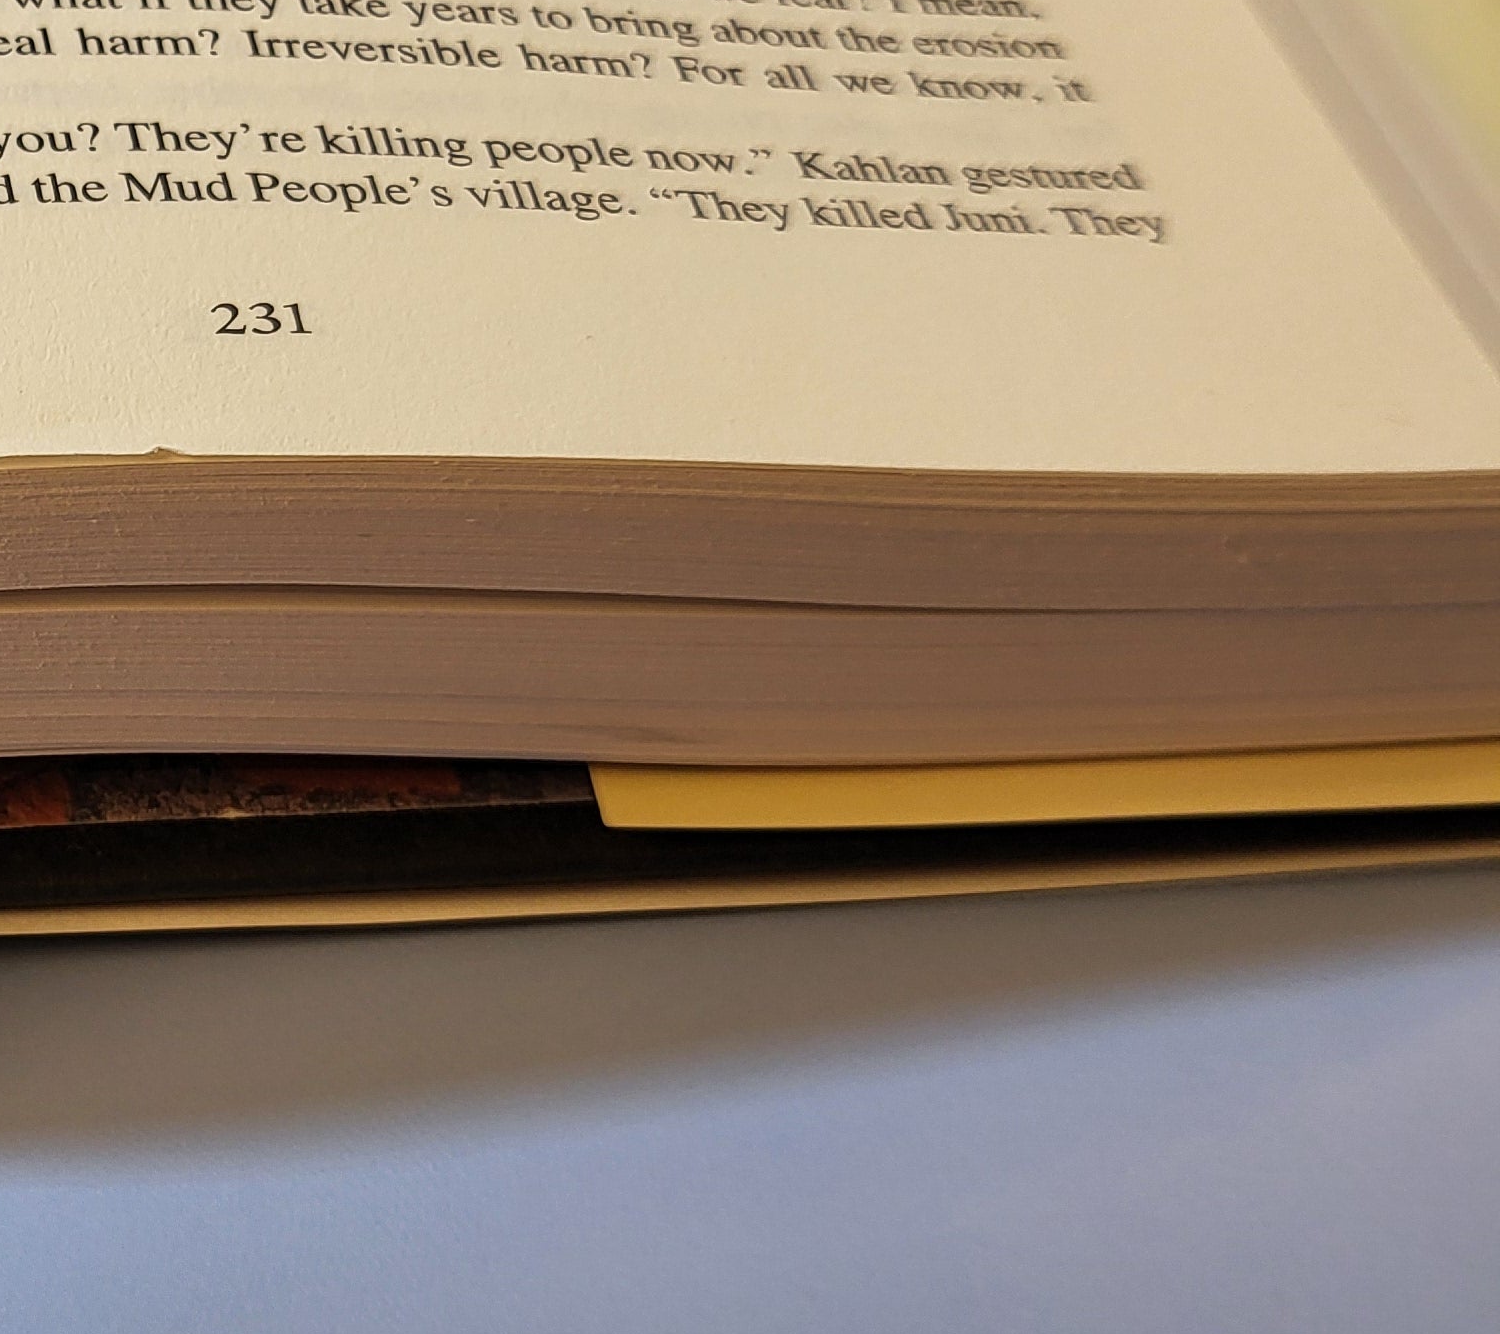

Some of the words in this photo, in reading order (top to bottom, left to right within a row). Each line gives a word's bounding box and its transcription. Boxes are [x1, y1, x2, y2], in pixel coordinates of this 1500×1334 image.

[75, 25, 221, 58] harm?
[243, 27, 503, 70] Irreversible
[516, 41, 653, 81] harm?
[670, 53, 745, 88] For
[763, 62, 820, 93] all
[832, 72, 896, 97] we
[906, 69, 1045, 105] know,
[1052, 74, 1094, 104] it
[401, 0, 520, 29] years
[529, 4, 575, 31] to
[581, 4, 702, 50] bring
[709, 16, 828, 52] about
[834, 24, 902, 56] the
[911, 31, 1067, 61] erosion
[112, 119, 308, 162] They’re
[313, 122, 474, 169] killing
[480, 135, 635, 175] people
[642, 146, 773, 177] now.”
[789, 149, 954, 188] Kahlan
[960, 161, 1146, 197] gestured
[30, 170, 110, 205] the
[118, 169, 239, 204] Mud
[244, 170, 455, 214] People’s
[463, 177, 638, 223] village.
[648, 186, 791, 234] “They
[799, 195, 936, 232] killed
[940, 201, 1052, 236] Juni.
[1052, 205, 1167, 246] They
[210, 302, 313, 335] 231
